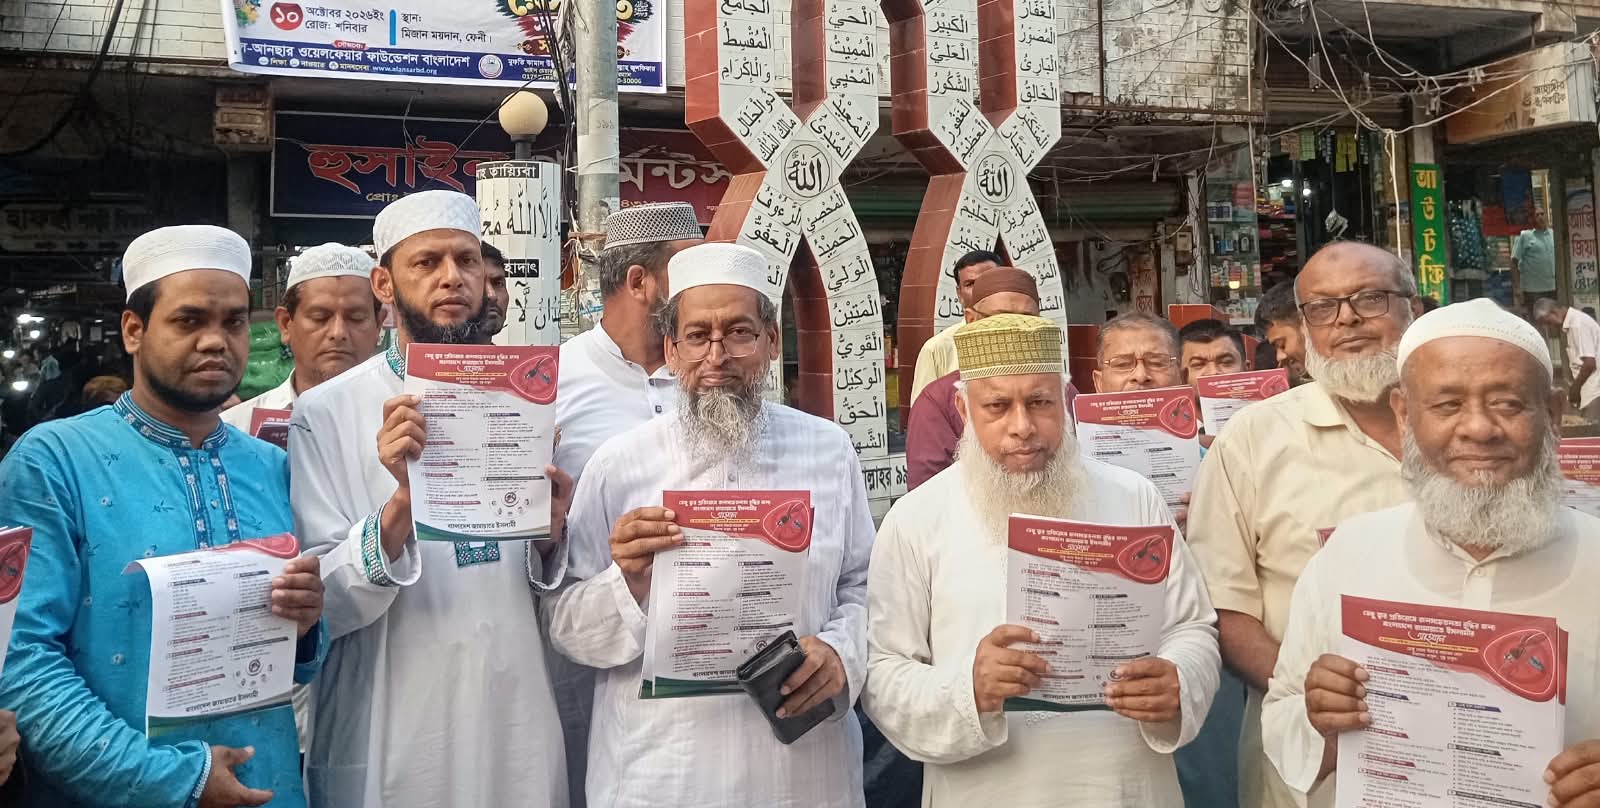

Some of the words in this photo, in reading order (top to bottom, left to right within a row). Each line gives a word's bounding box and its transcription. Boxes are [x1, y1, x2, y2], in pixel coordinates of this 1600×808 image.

[274, 6, 300, 23] ১০
[305, 6, 342, 18] অক্টোবর
[401, 13, 422, 24] স্থান:
[334, 21, 368, 34] শনিবার
[401, 26, 428, 40] মিজান
[431, 31, 462, 43] ময়দান,
[298, 48, 362, 62] ওয়েলফেয়ার
[366, 50, 419, 64] ফাউন্ডেশন
[420, 54, 470, 68] বাংলাদেশ
[1414, 169, 1445, 299] আউটফি
[504, 262, 538, 274] হাদাৎ
